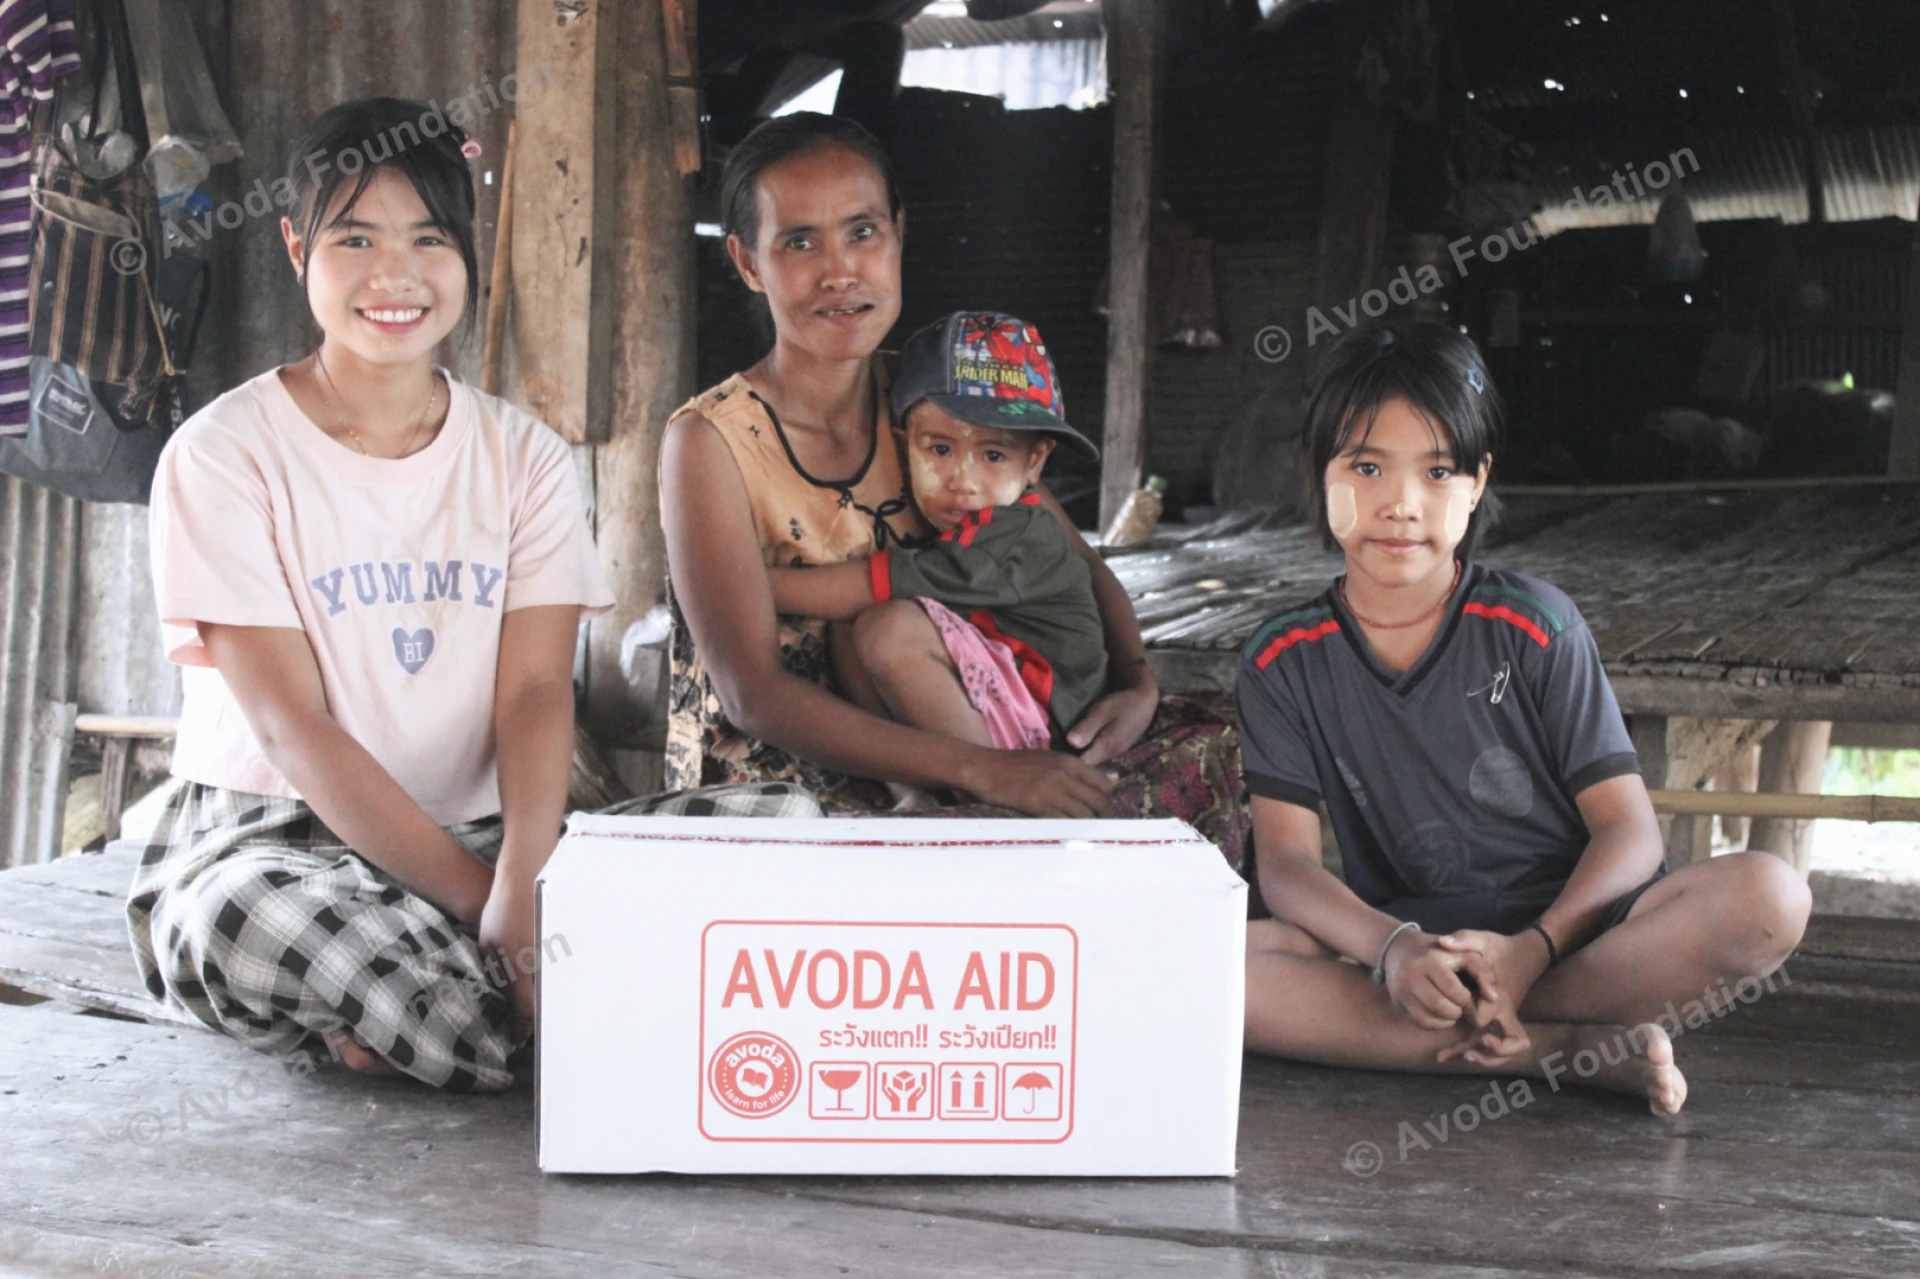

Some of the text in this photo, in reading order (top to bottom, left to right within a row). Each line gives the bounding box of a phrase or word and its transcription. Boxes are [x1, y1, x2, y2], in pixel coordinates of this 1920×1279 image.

[311, 560, 503, 617] YUMMY
[403, 641, 426, 663] BI
[721, 948, 1056, 1011] AVODA AID
[819, 1023, 928, 1048] ระวังแตก!!
[725, 1043, 785, 1069] avoda
[725, 1089, 785, 1109] learn for life
